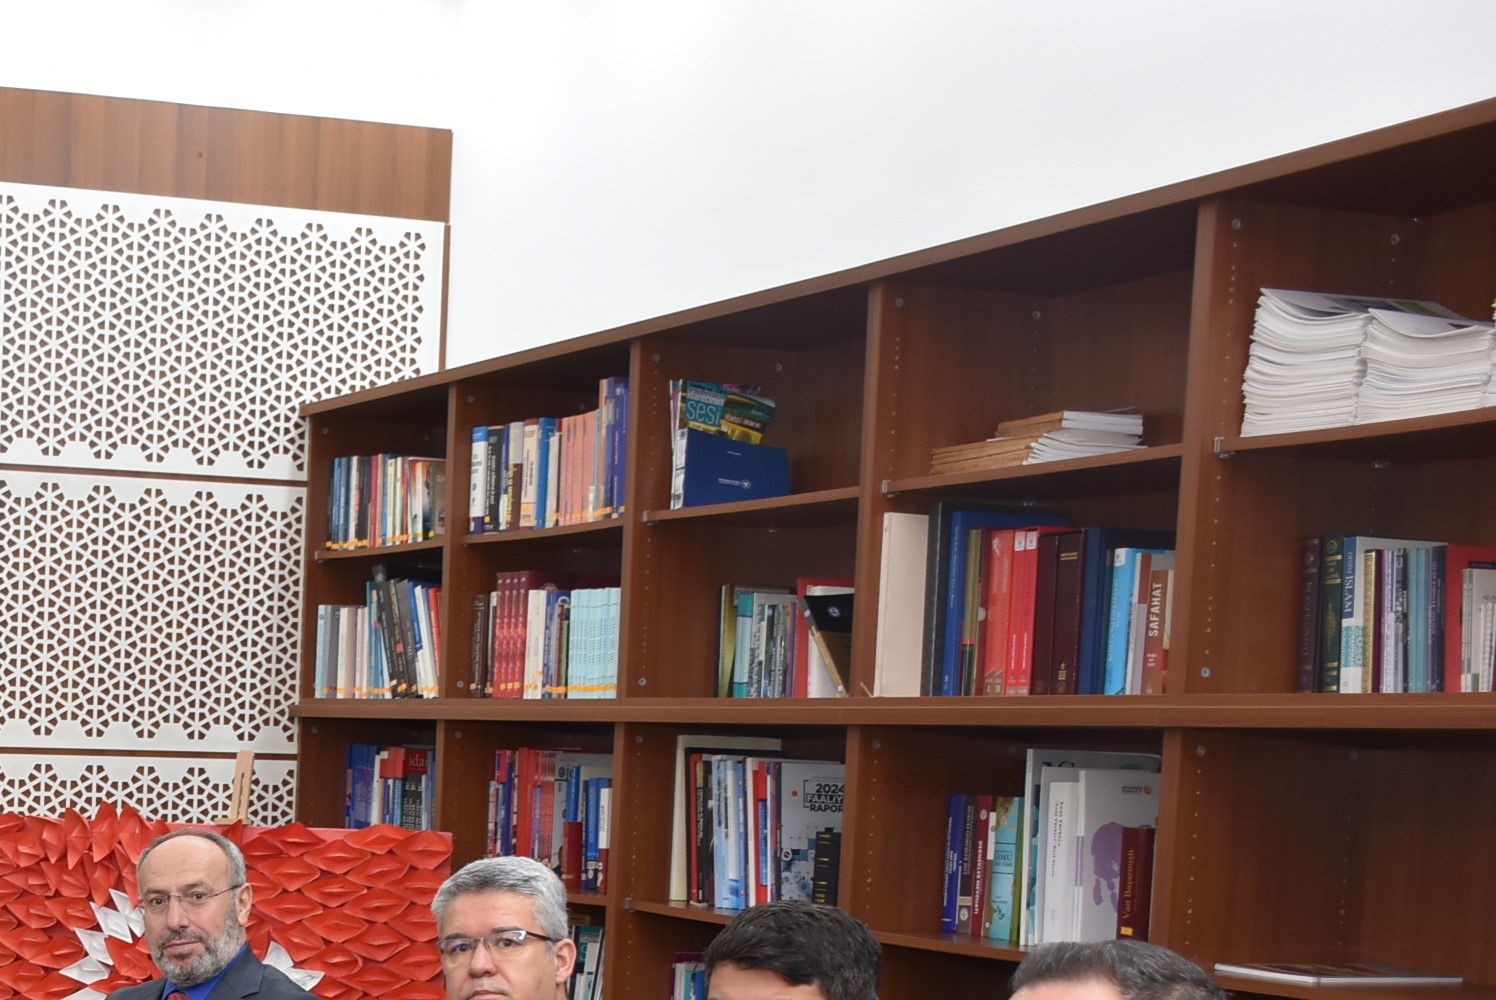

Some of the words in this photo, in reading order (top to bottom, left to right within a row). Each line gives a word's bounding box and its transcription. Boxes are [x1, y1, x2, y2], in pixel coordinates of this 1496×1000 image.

[686, 400, 721, 426] sesi
[1148, 582, 1162, 637] SAFAHAT
[816, 783, 845, 793] 2024
[1122, 901, 1131, 919] Van
